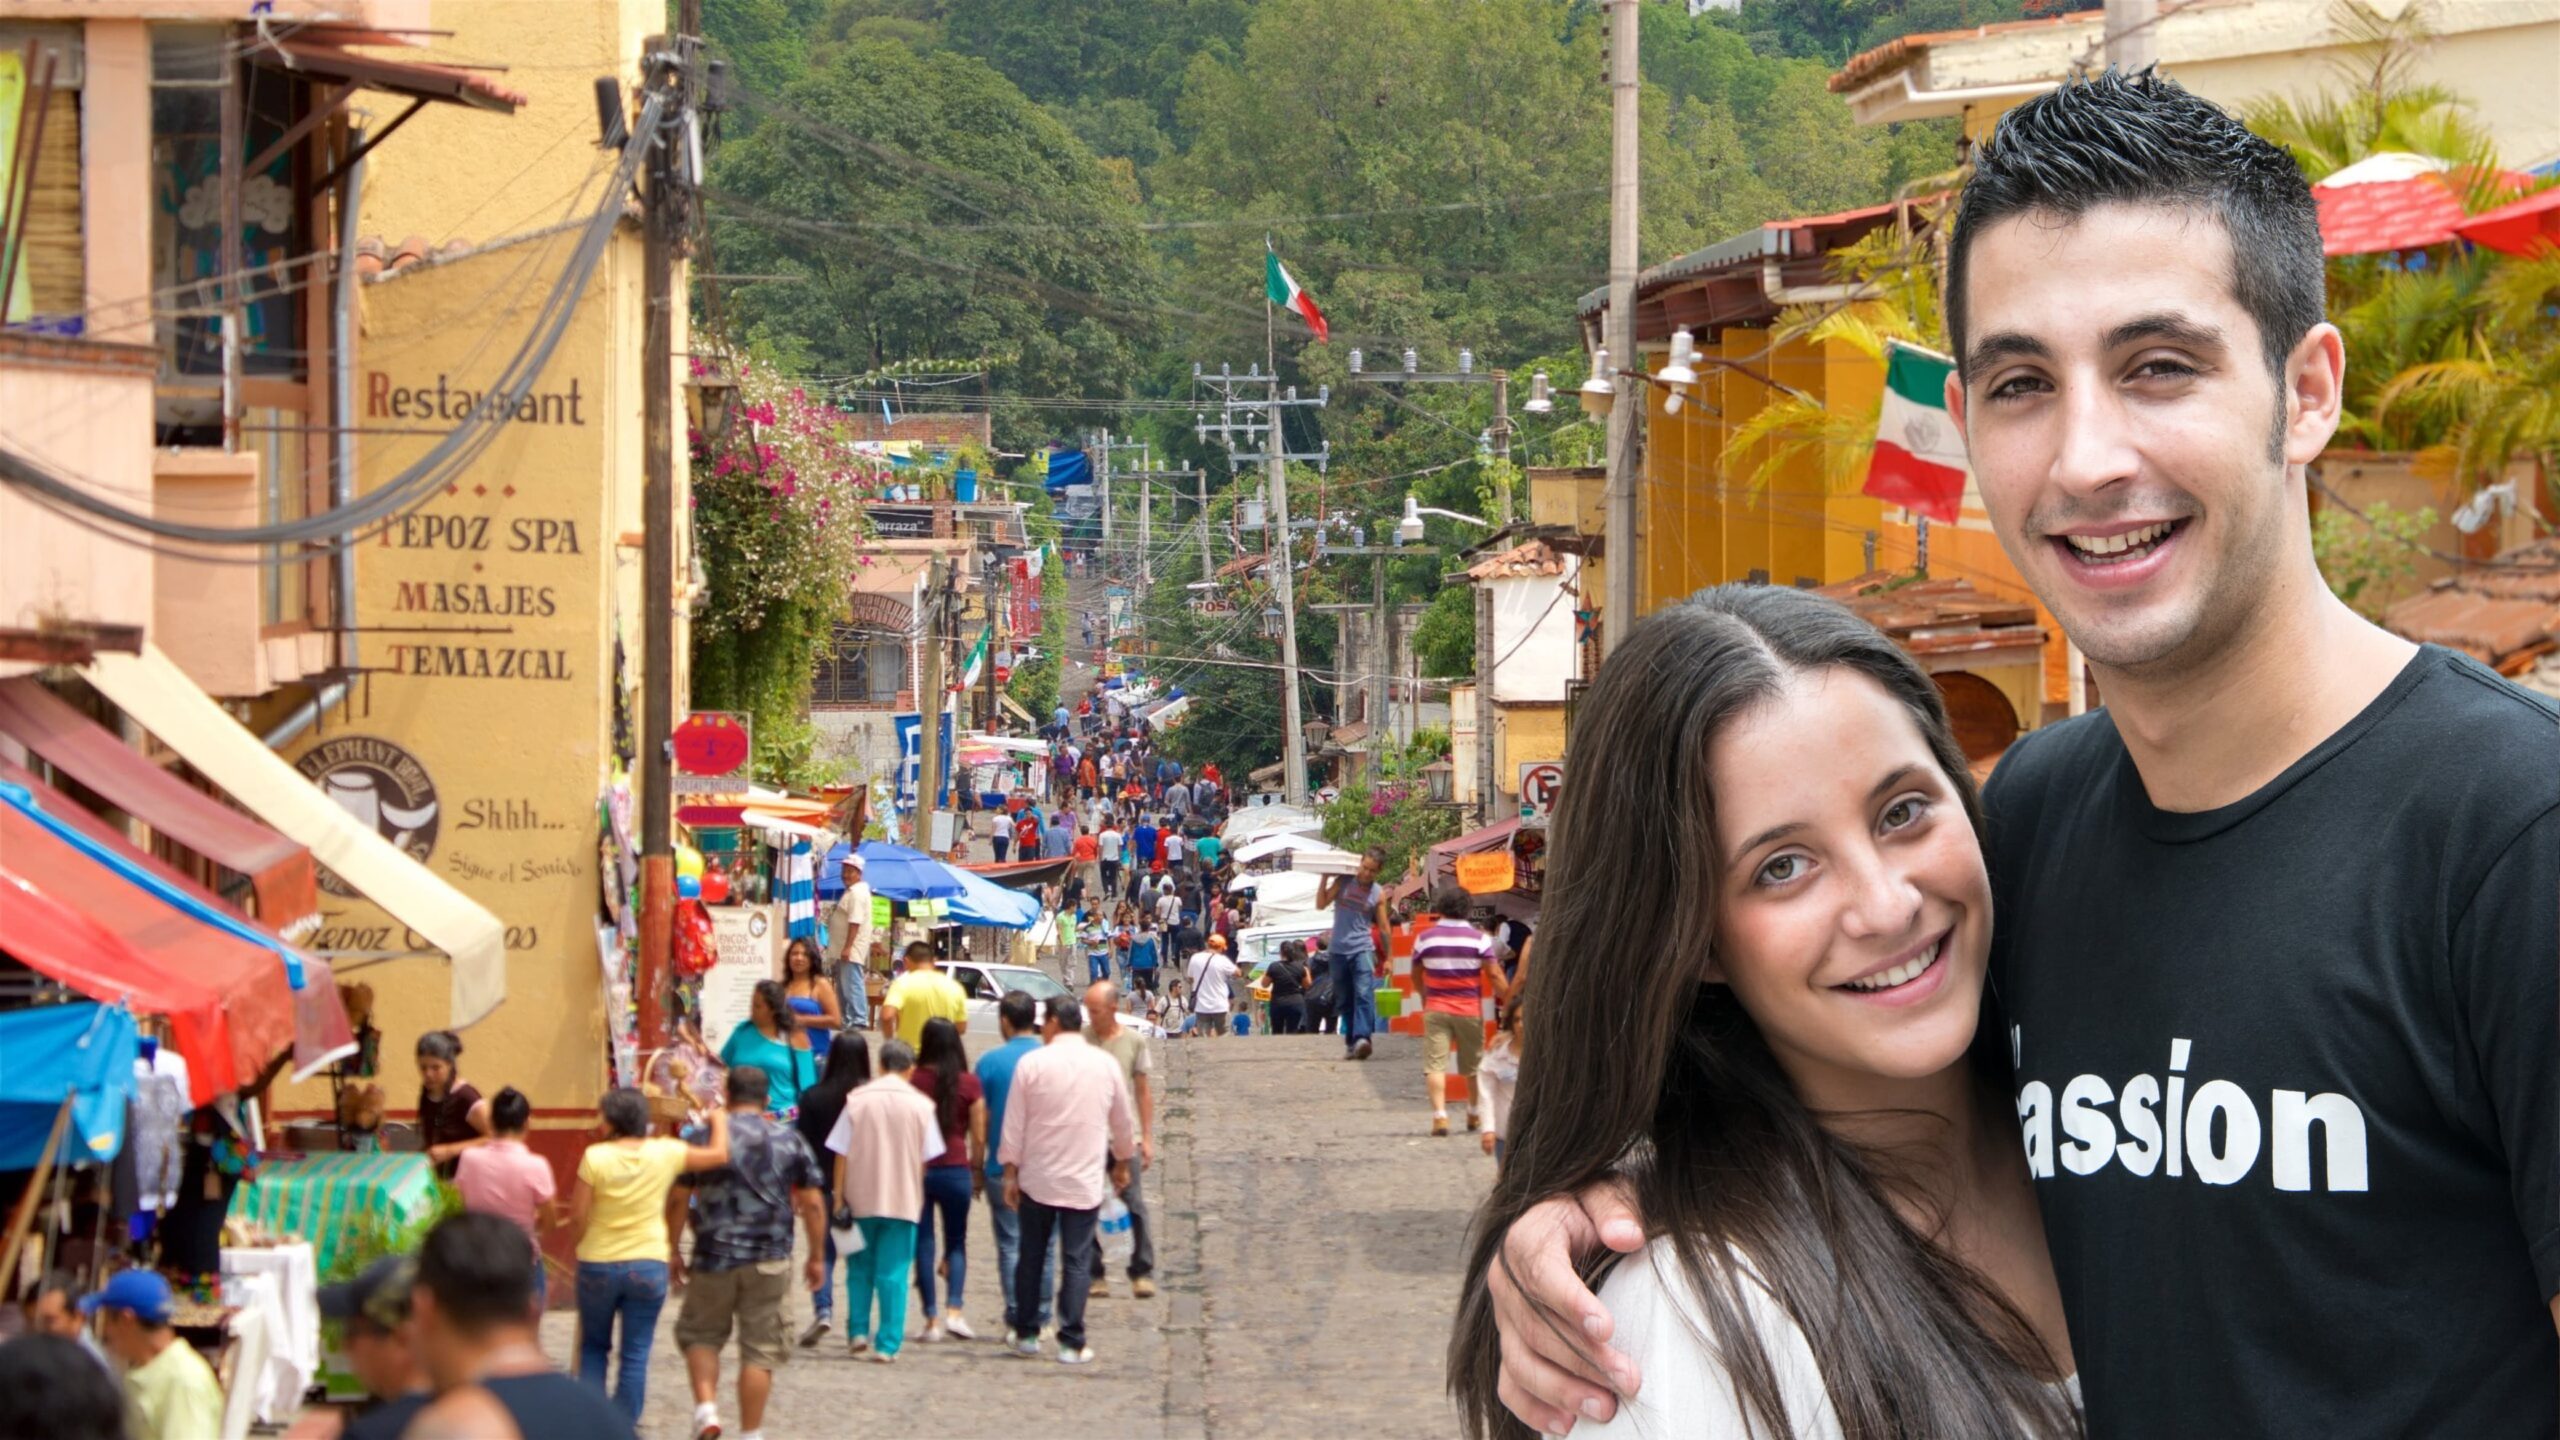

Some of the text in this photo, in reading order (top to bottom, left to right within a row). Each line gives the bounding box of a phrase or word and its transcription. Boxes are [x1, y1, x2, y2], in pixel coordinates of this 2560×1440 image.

[376, 513, 582, 554] TEPOZ SPA
[392, 581, 556, 617] MASAJES
[386, 644, 574, 681] TEMAZCAL
[300, 738, 399, 778] ELEPHANT
[455, 798, 564, 831] Shhh...
[2017, 1038, 2369, 1192] assion
